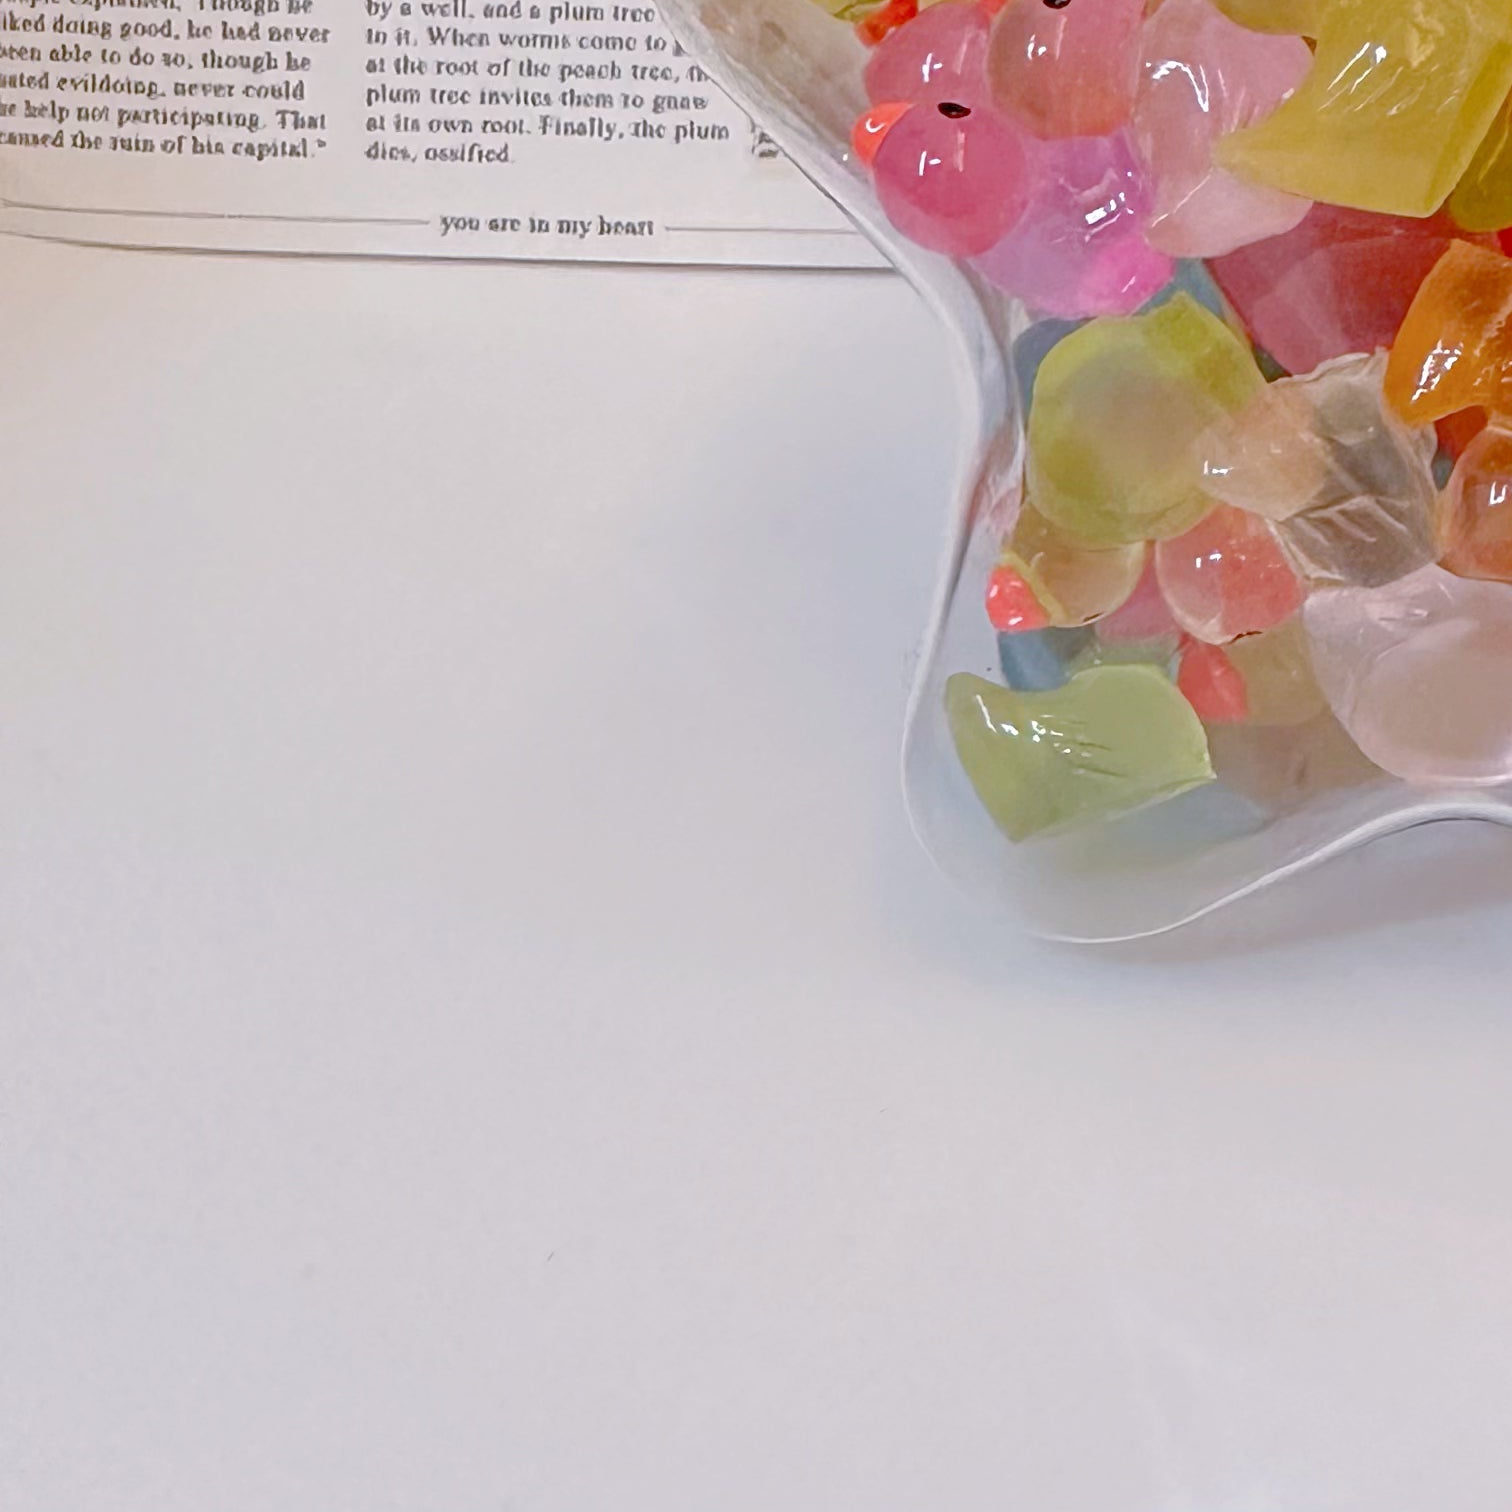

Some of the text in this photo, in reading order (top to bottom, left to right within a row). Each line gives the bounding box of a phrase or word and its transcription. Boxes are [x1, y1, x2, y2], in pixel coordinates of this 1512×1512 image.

[439, 215, 653, 238] you are in my heart
